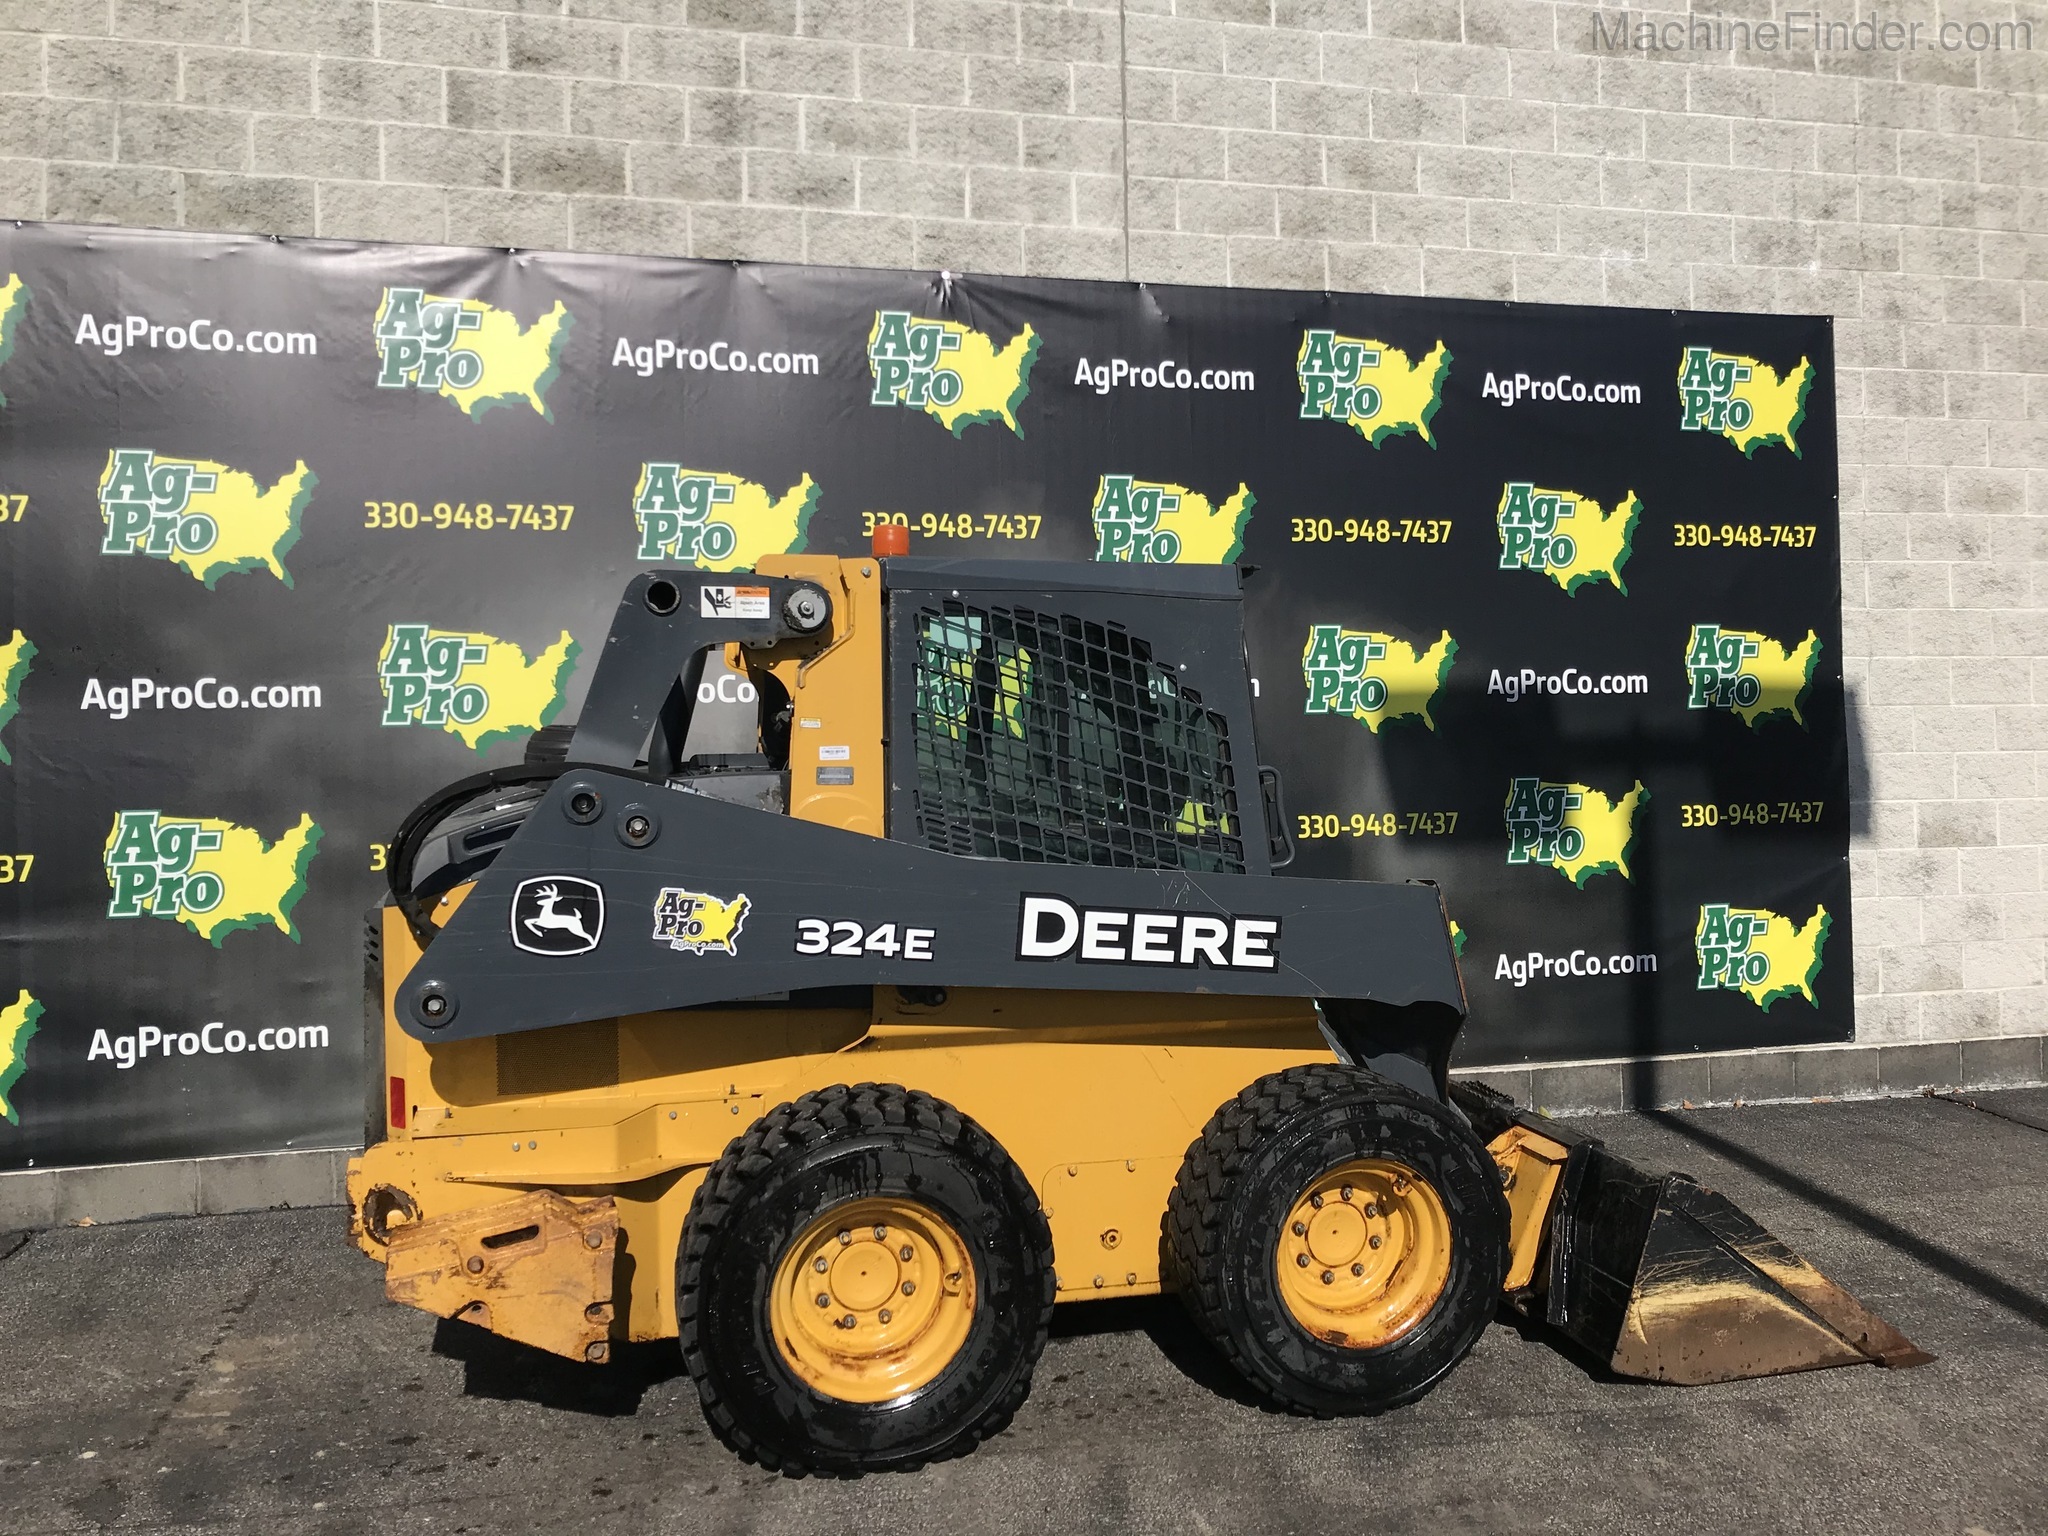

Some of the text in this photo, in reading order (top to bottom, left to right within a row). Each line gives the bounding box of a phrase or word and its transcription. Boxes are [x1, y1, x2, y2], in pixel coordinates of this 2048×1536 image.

[75, 314, 316, 355] AgProCo.com
[376, 288, 482, 349] Ag-
[868, 311, 961, 368] Ag-
[376, 337, 482, 388] Pro
[613, 338, 818, 376] AgProCo.com
[1075, 358, 1254, 394] AgProCo.com
[1300, 330, 1380, 383] Ag-
[1678, 348, 1751, 398] Ag-
[868, 357, 961, 405] Pro
[1300, 373, 1380, 418] Pro
[1482, 373, 1640, 406] AgProCo.com
[1678, 388, 1751, 430] Pro
[101, 449, 216, 512] Ag-
[636, 463, 735, 522] Ag-
[1095, 476, 1180, 530] Ag-
[101, 499, 216, 553] Pro
[366, 502, 573, 530] 330-948-7437
[1292, 518, 1451, 543] 330-948-7437
[1500, 483, 1575, 534] Ag-
[636, 510, 735, 560] Pro
[1095, 520, 1180, 563] Pro
[1500, 524, 1575, 568] Pro
[1675, 524, 1816, 547] 330-948-7437
[381, 625, 487, 686] Ag-
[1306, 626, 1386, 679] Ag-
[1688, 625, 1760, 675] Ag-
[81, 678, 321, 719] AgProCo.com
[381, 674, 487, 725] Pro
[1306, 668, 1386, 713] Pro
[1488, 669, 1648, 702] AgProCo.com
[1688, 665, 1760, 708] Pro
[1298, 813, 1456, 839] 330-948-7437
[1508, 778, 1584, 830] Ag-
[1681, 803, 1822, 827] 330-948-7437
[107, 810, 222, 874] Ag-
[1508, 820, 1584, 864] Pro
[107, 861, 222, 916] Pro
[658, 890, 705, 920] Ag-
[657, 914, 704, 938] Pro
[796, 919, 934, 960] 324E
[1021, 896, 1276, 968] DEERE
[1698, 905, 1769, 955] Ag-
[1495, 950, 1656, 986] AgProCo.com
[1698, 945, 1769, 988] Pro
[88, 1023, 328, 1068] AgProCo.com
